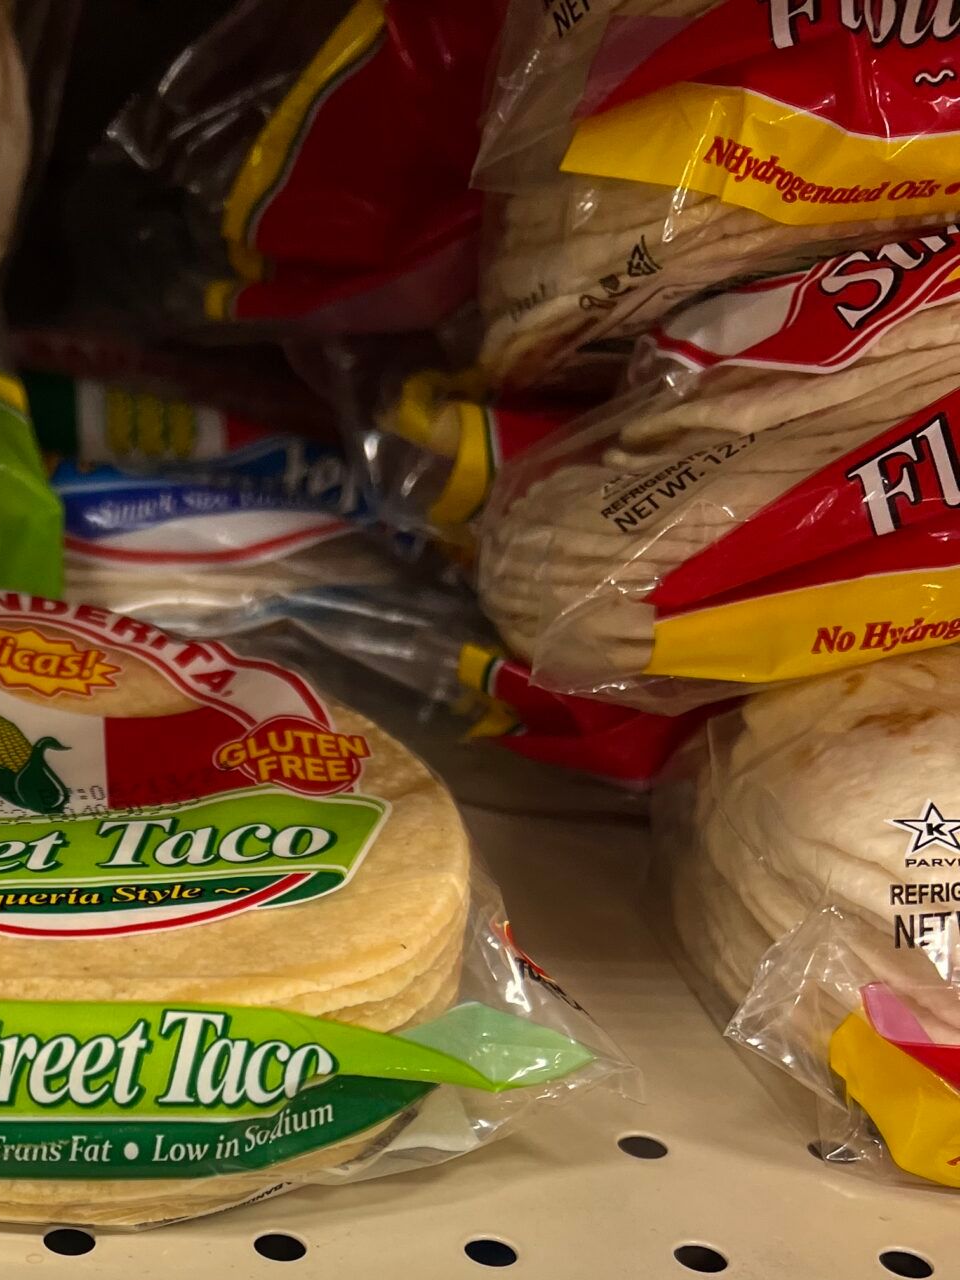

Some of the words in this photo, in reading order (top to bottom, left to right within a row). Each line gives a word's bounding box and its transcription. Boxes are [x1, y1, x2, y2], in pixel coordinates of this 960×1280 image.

[888, 179, 942, 201] Oils
[614, 494, 660, 533] NET
[656, 466, 706, 499] WT.
[811, 625, 856, 654] No
[219, 729, 368, 770] GLUTEN
[256, 754, 352, 784] FREE
[97, 817, 338, 868] Taco
[905, 858, 960, 868] PARV
[112, 883, 202, 906] Style
[157, 1009, 338, 1107] Taco
[68, 1135, 113, 1162] Fat
[151, 1135, 209, 1162] Low
[215, 1134, 240, 1160] in
[244, 1102, 334, 1153] Sodium
